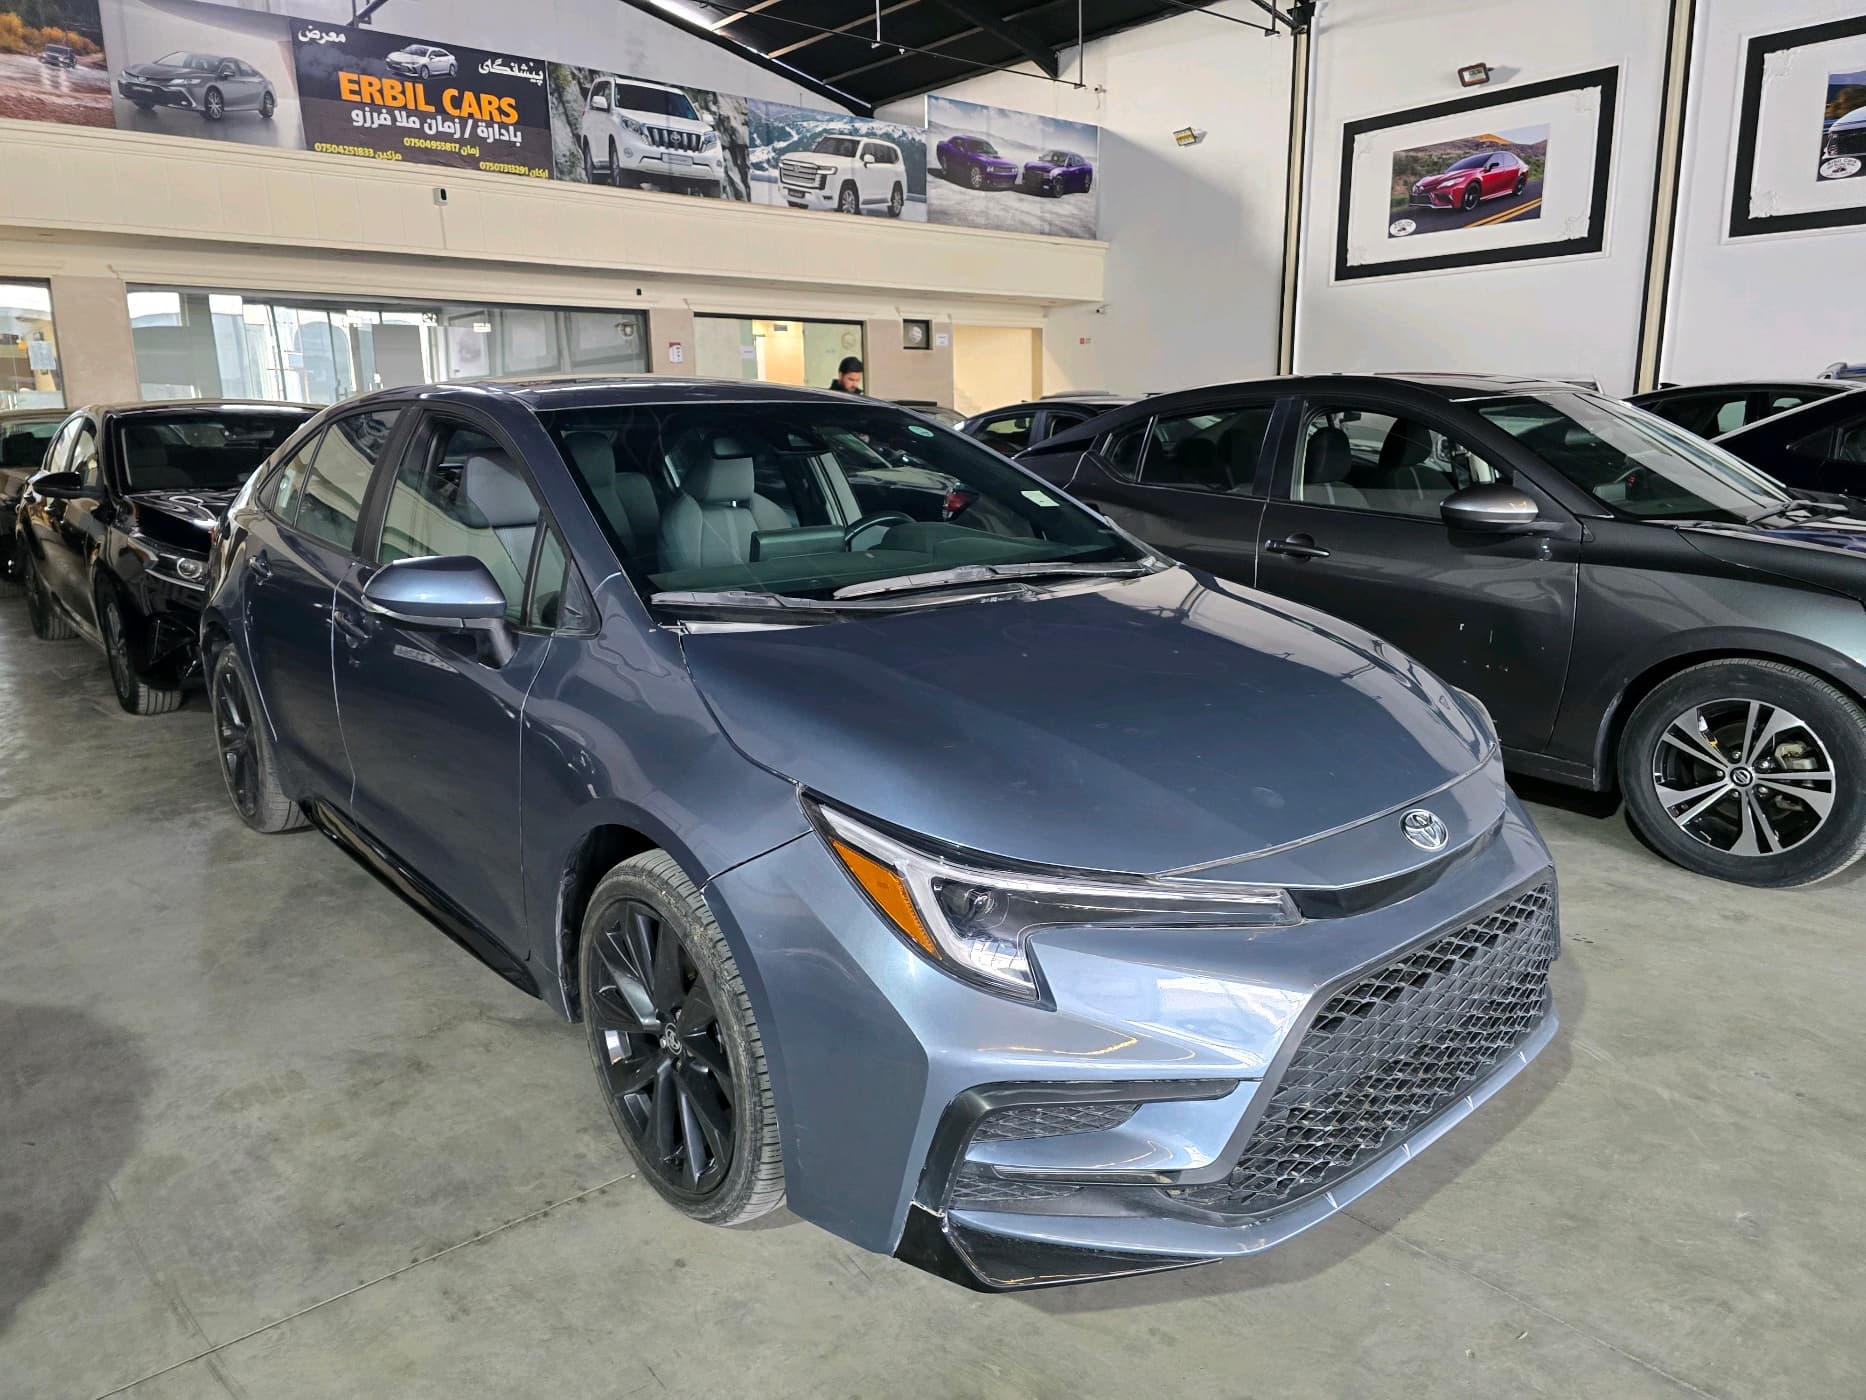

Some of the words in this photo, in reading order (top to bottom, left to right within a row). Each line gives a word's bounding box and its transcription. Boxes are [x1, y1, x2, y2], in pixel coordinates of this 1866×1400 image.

[298, 25, 347, 44] معرض
[338, 71, 435, 112] ERBIL
[442, 88, 519, 124] CARS
[350, 106, 392, 128] فرزو
[394, 109, 420, 129] ملا
[423, 116, 461, 139] زمان
[314, 142, 375, 158] 07504251833
[403, 137, 460, 153] 07504955817
[460, 145, 480, 157] زمان
